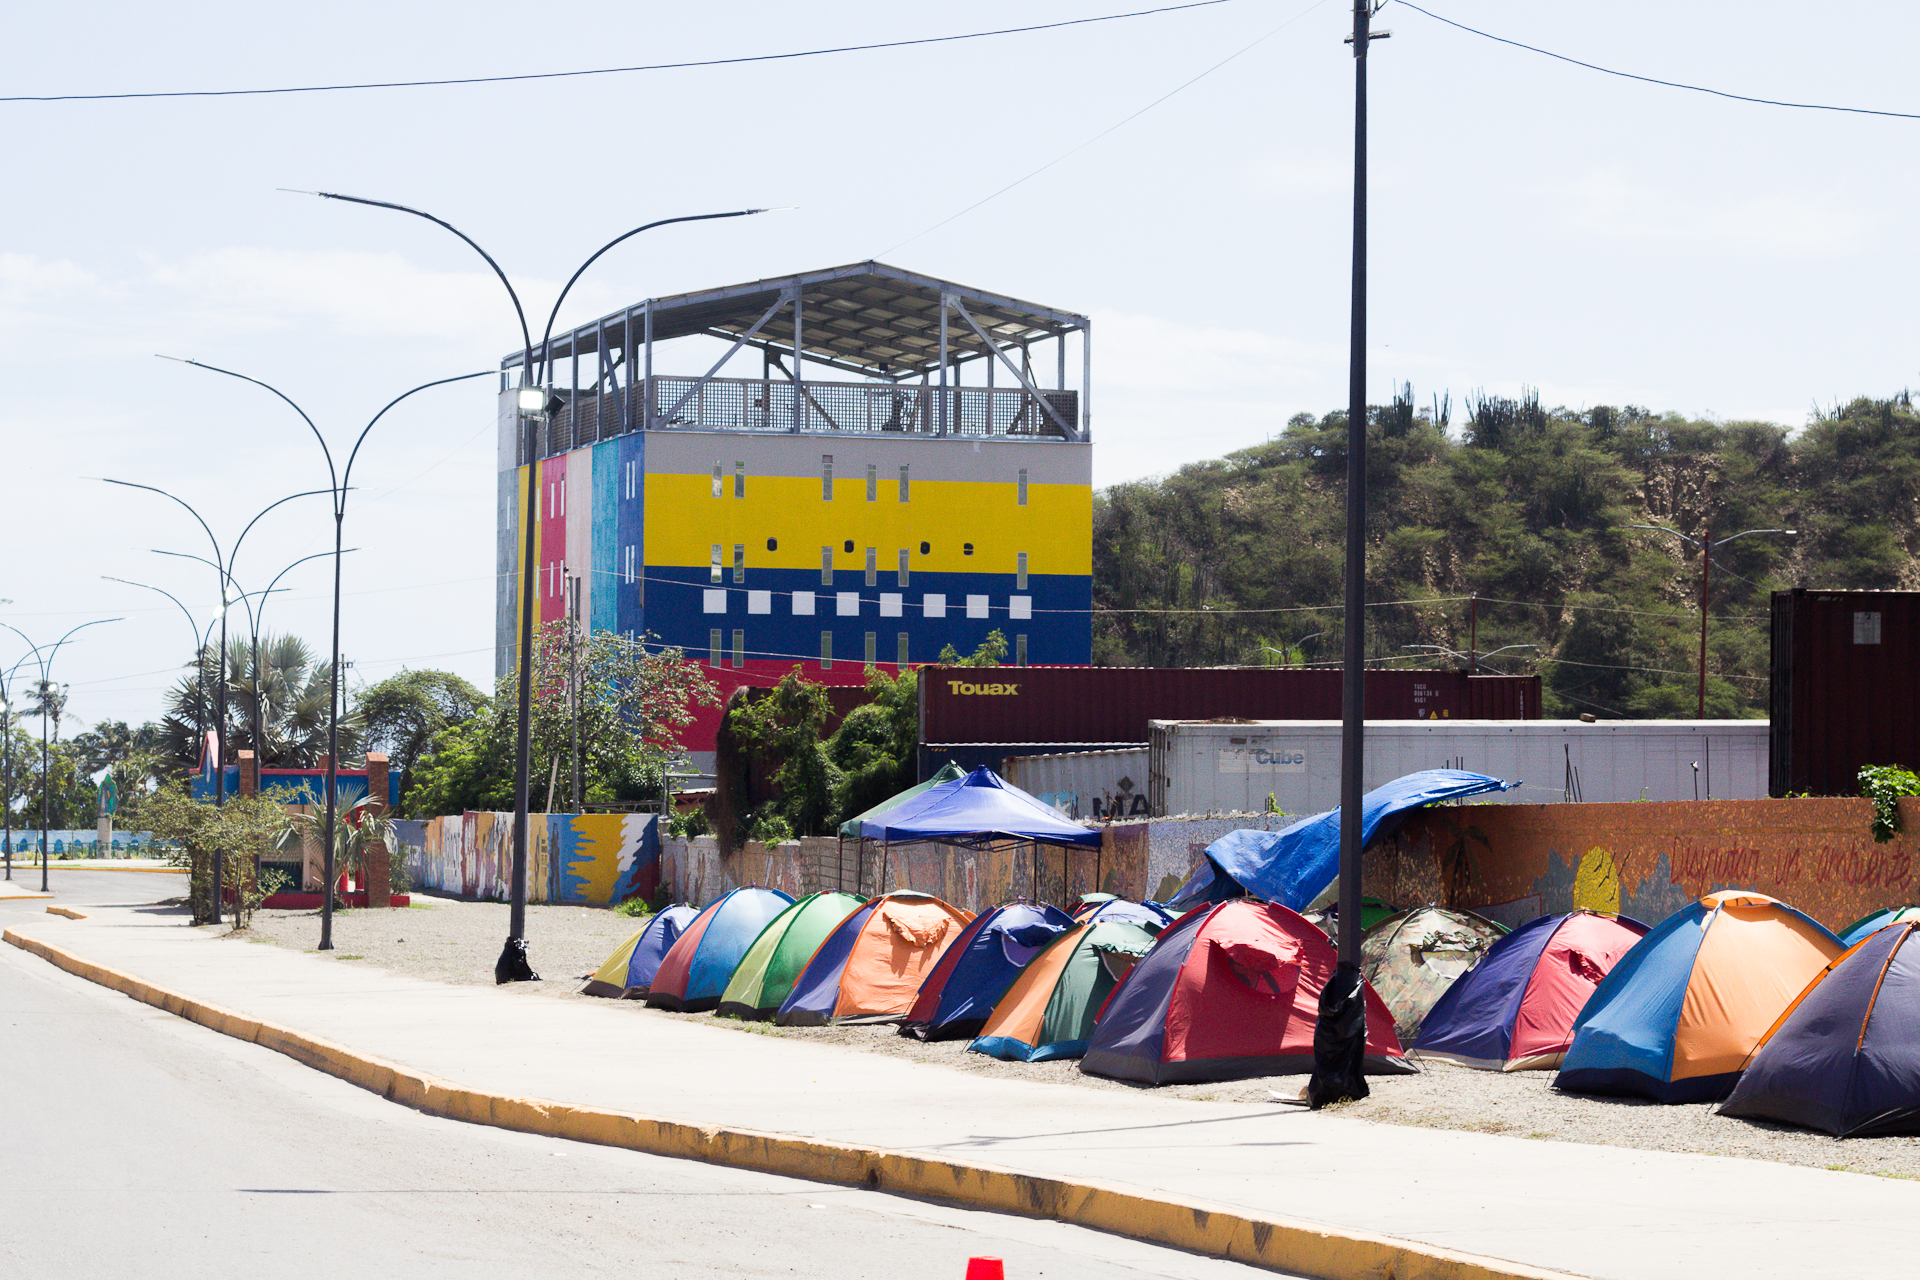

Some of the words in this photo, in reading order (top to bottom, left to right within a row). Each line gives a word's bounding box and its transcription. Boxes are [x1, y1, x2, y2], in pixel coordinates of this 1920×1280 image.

[947, 680, 1019, 696] Touax
[1255, 750, 1305, 766] Cube
[1775, 846, 1801, 886] un
